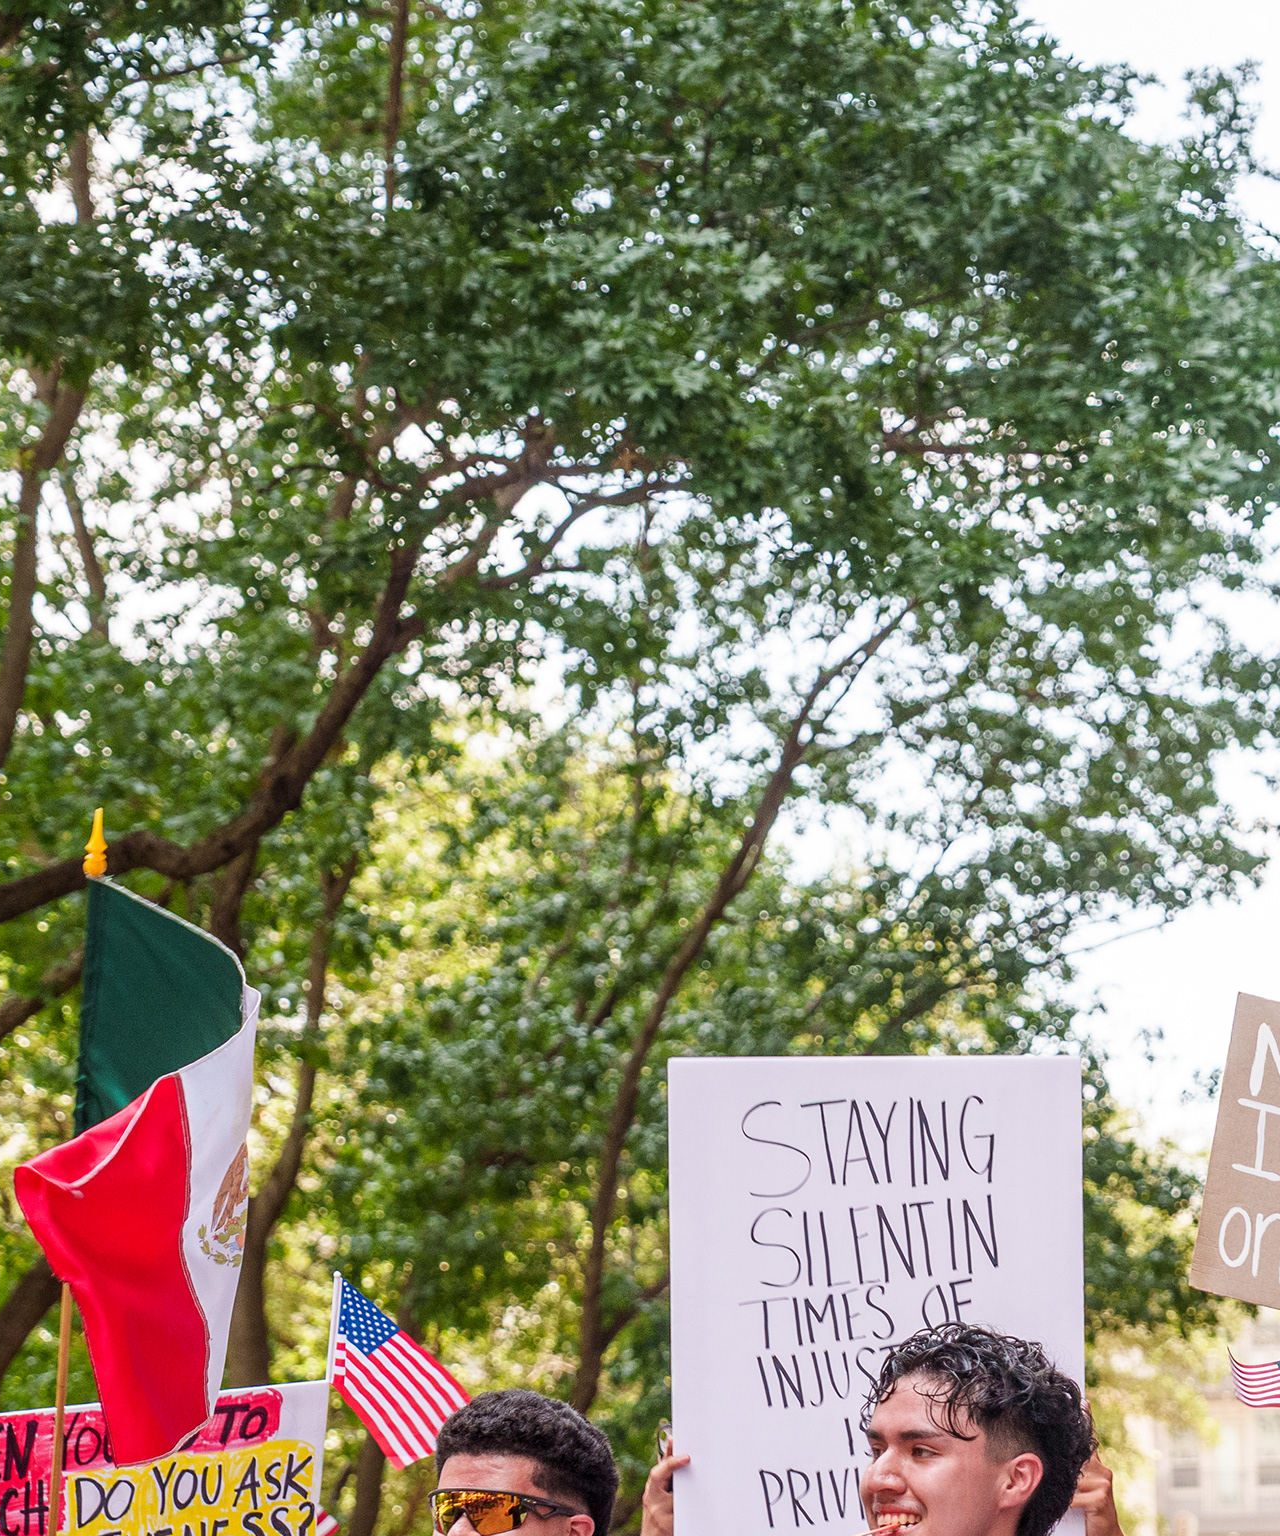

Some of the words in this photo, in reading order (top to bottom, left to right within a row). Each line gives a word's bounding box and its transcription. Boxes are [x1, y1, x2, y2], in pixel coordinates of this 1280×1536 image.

[740, 1094, 996, 1199] STAYING
[738, 1283, 896, 1350] TIMES
[921, 1279, 973, 1329] OF
[214, 1403, 269, 1445] TO
[75, 1477, 133, 1528] DO
[155, 1461, 223, 1516] YOU
[232, 1453, 313, 1510] ASK
